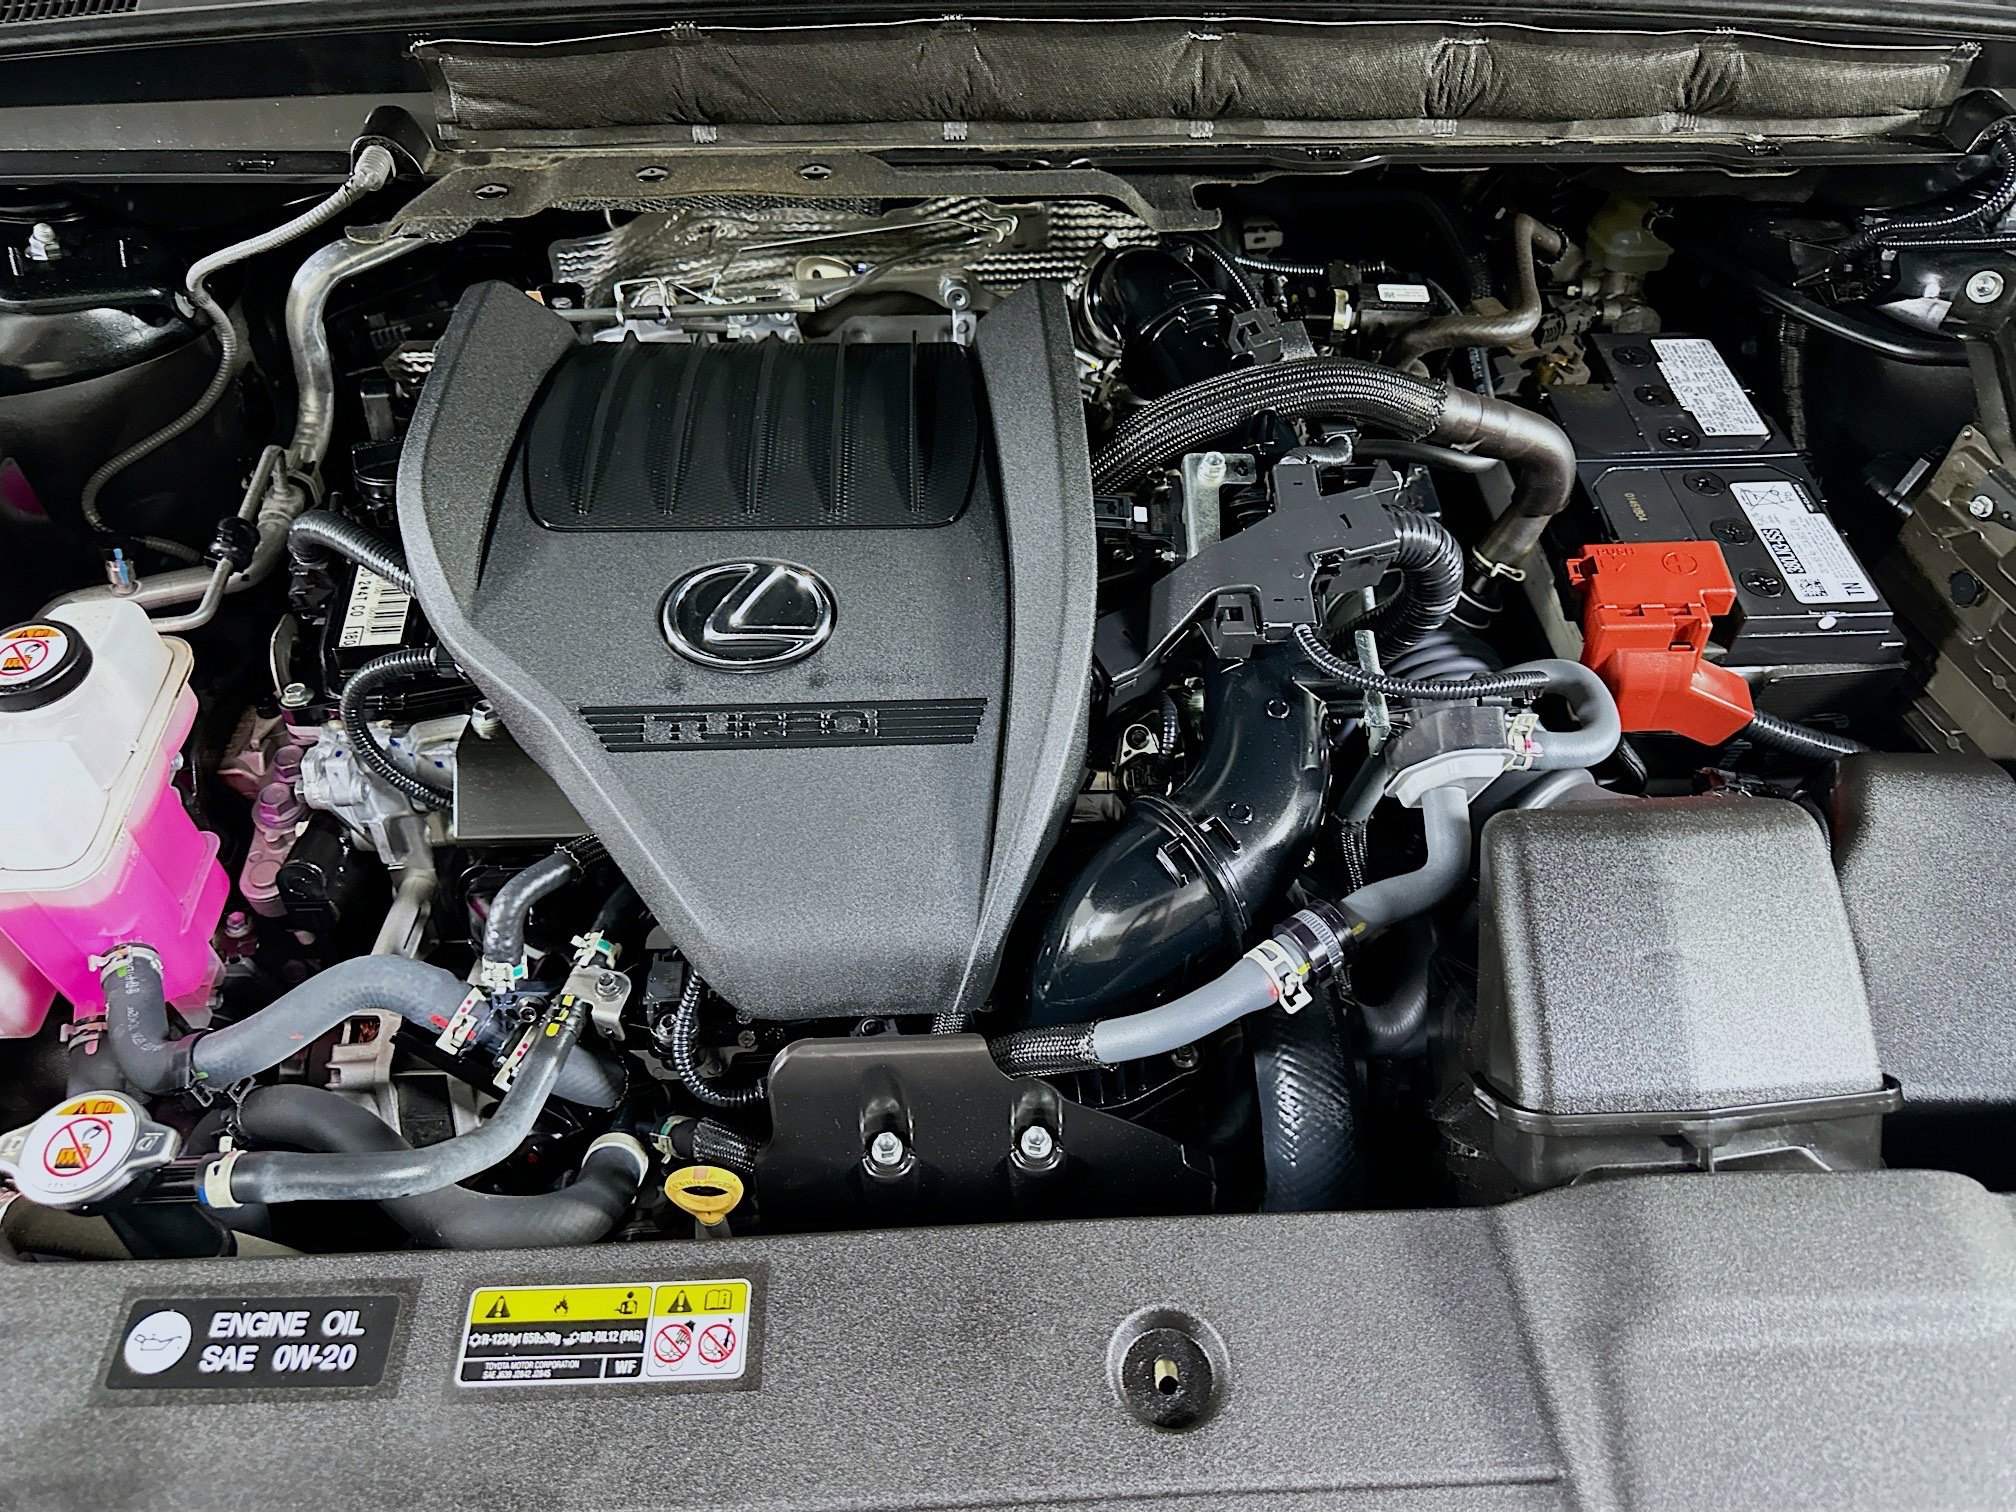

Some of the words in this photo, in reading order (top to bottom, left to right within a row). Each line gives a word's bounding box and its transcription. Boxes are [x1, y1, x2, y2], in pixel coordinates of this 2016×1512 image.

[1841, 581, 1866, 597] TN
[650, 710, 871, 742] TURBO
[208, 1311, 310, 1338] ENGINE
[322, 1310, 366, 1337] OIL
[199, 1344, 259, 1374] SAE
[272, 1344, 358, 1372] 0W-20
[485, 1361, 510, 1371] TOYOTA
[511, 1361, 534, 1370] MOTOR
[535, 1359, 580, 1370] CORPORATION
[482, 1370, 497, 1380] SAE
[615, 1360, 638, 1375] WF
